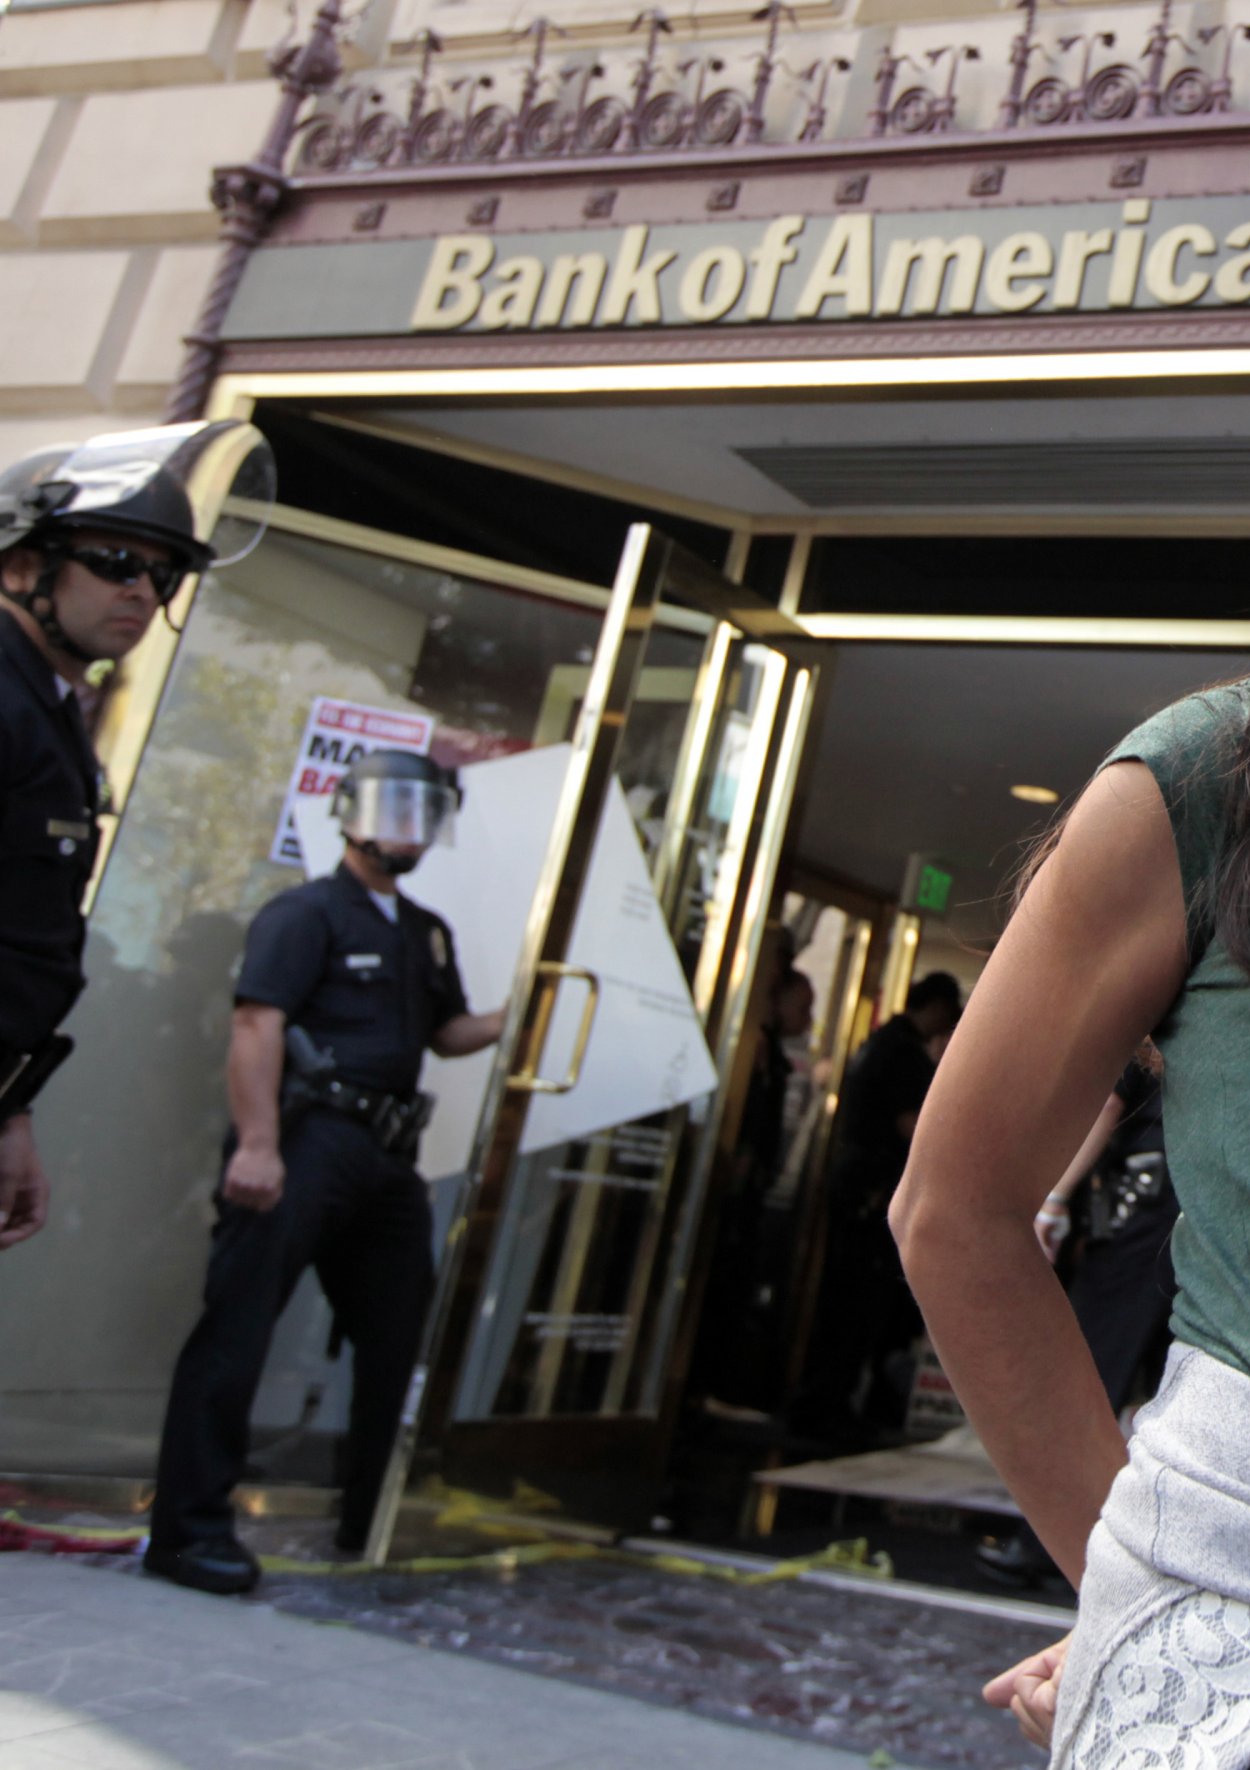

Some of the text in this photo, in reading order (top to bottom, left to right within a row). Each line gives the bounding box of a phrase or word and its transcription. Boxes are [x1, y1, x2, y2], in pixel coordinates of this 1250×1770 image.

[410, 224, 678, 330] Bank
[679, 215, 804, 322] of
[308, 735, 367, 764] MA
